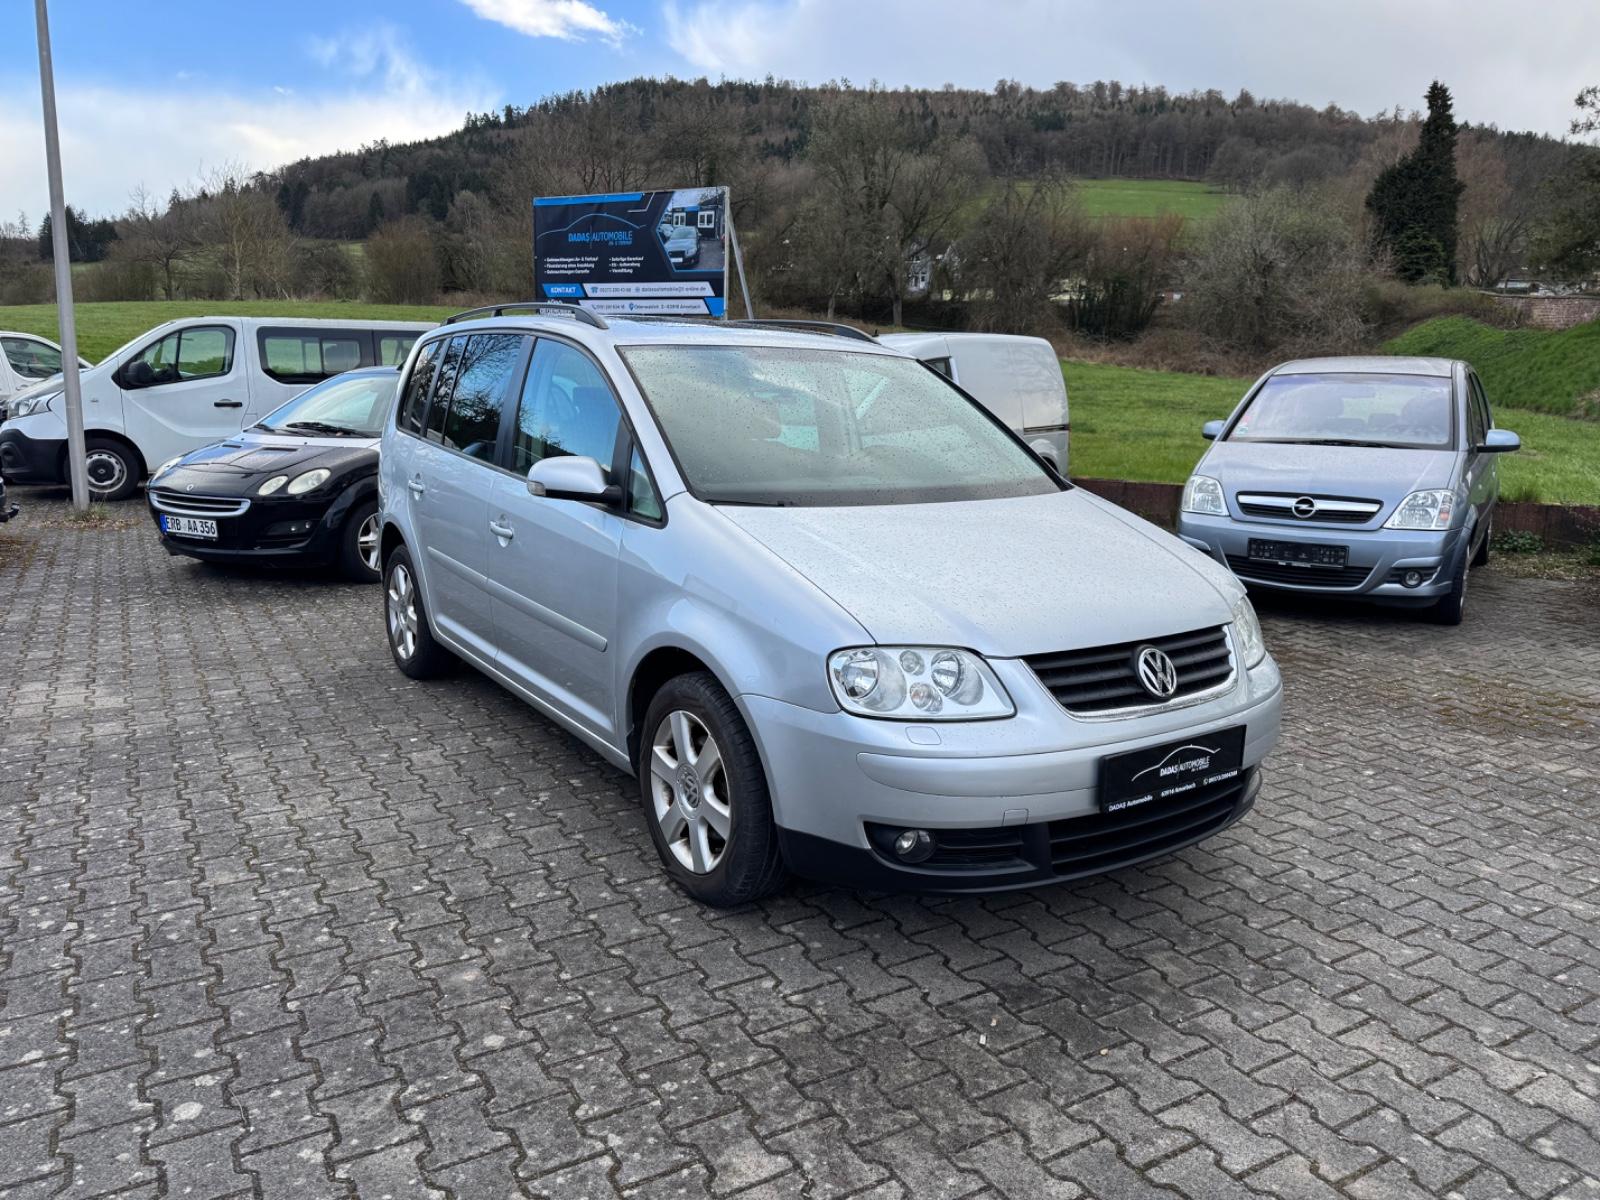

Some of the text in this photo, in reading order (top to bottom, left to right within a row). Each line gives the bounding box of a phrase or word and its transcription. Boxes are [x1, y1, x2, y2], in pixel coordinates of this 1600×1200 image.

[568, 230, 633, 243] DADAS AUTOMOBILE
[550, 286, 577, 294] KONTAKT
[166, 516, 216, 535] ERB AA 356
[1160, 764, 1178, 777] DADAS
[1179, 756, 1210, 770] AUTOMOBILE
[1109, 802, 1126, 812] DADAS
